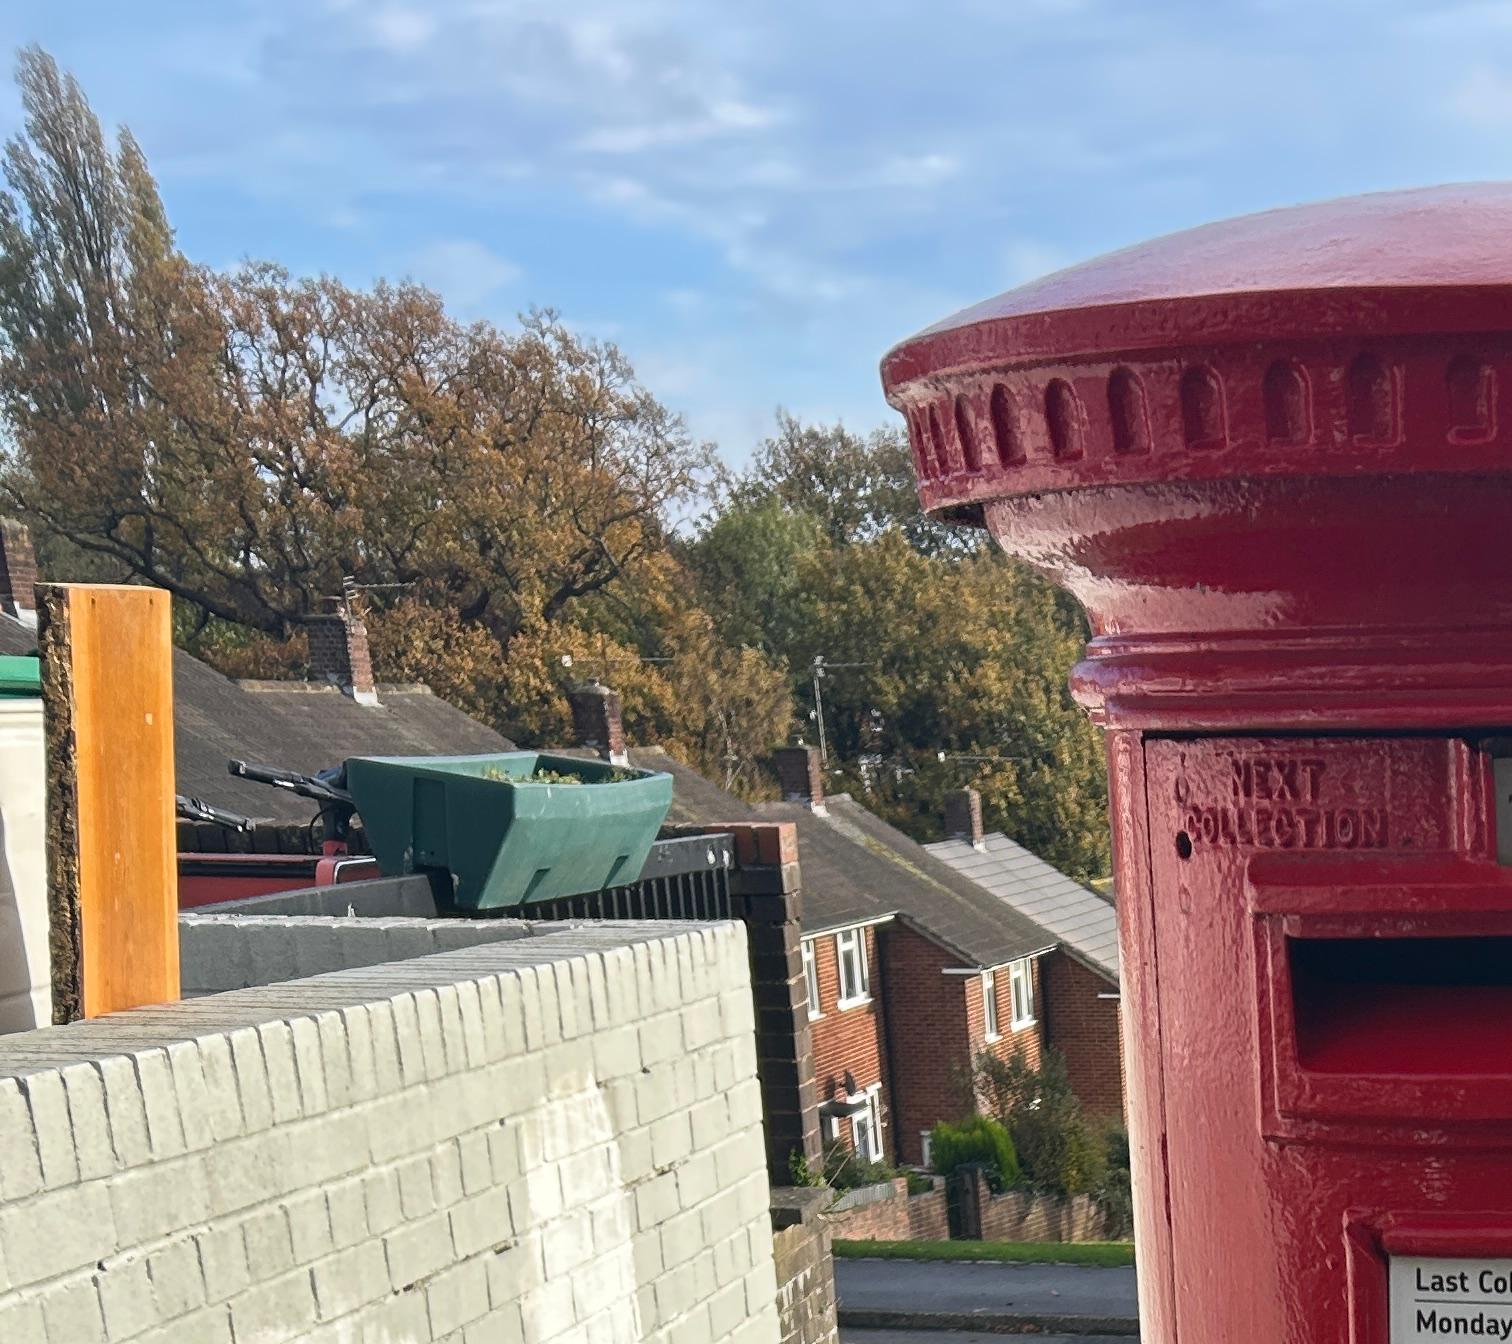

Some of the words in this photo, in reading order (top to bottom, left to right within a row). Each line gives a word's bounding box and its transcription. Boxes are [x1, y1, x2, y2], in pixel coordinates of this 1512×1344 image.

[1231, 757, 1326, 805] NEXT
[1185, 804, 1392, 850] COLLECTION
[1416, 1266, 1470, 1293] Last
